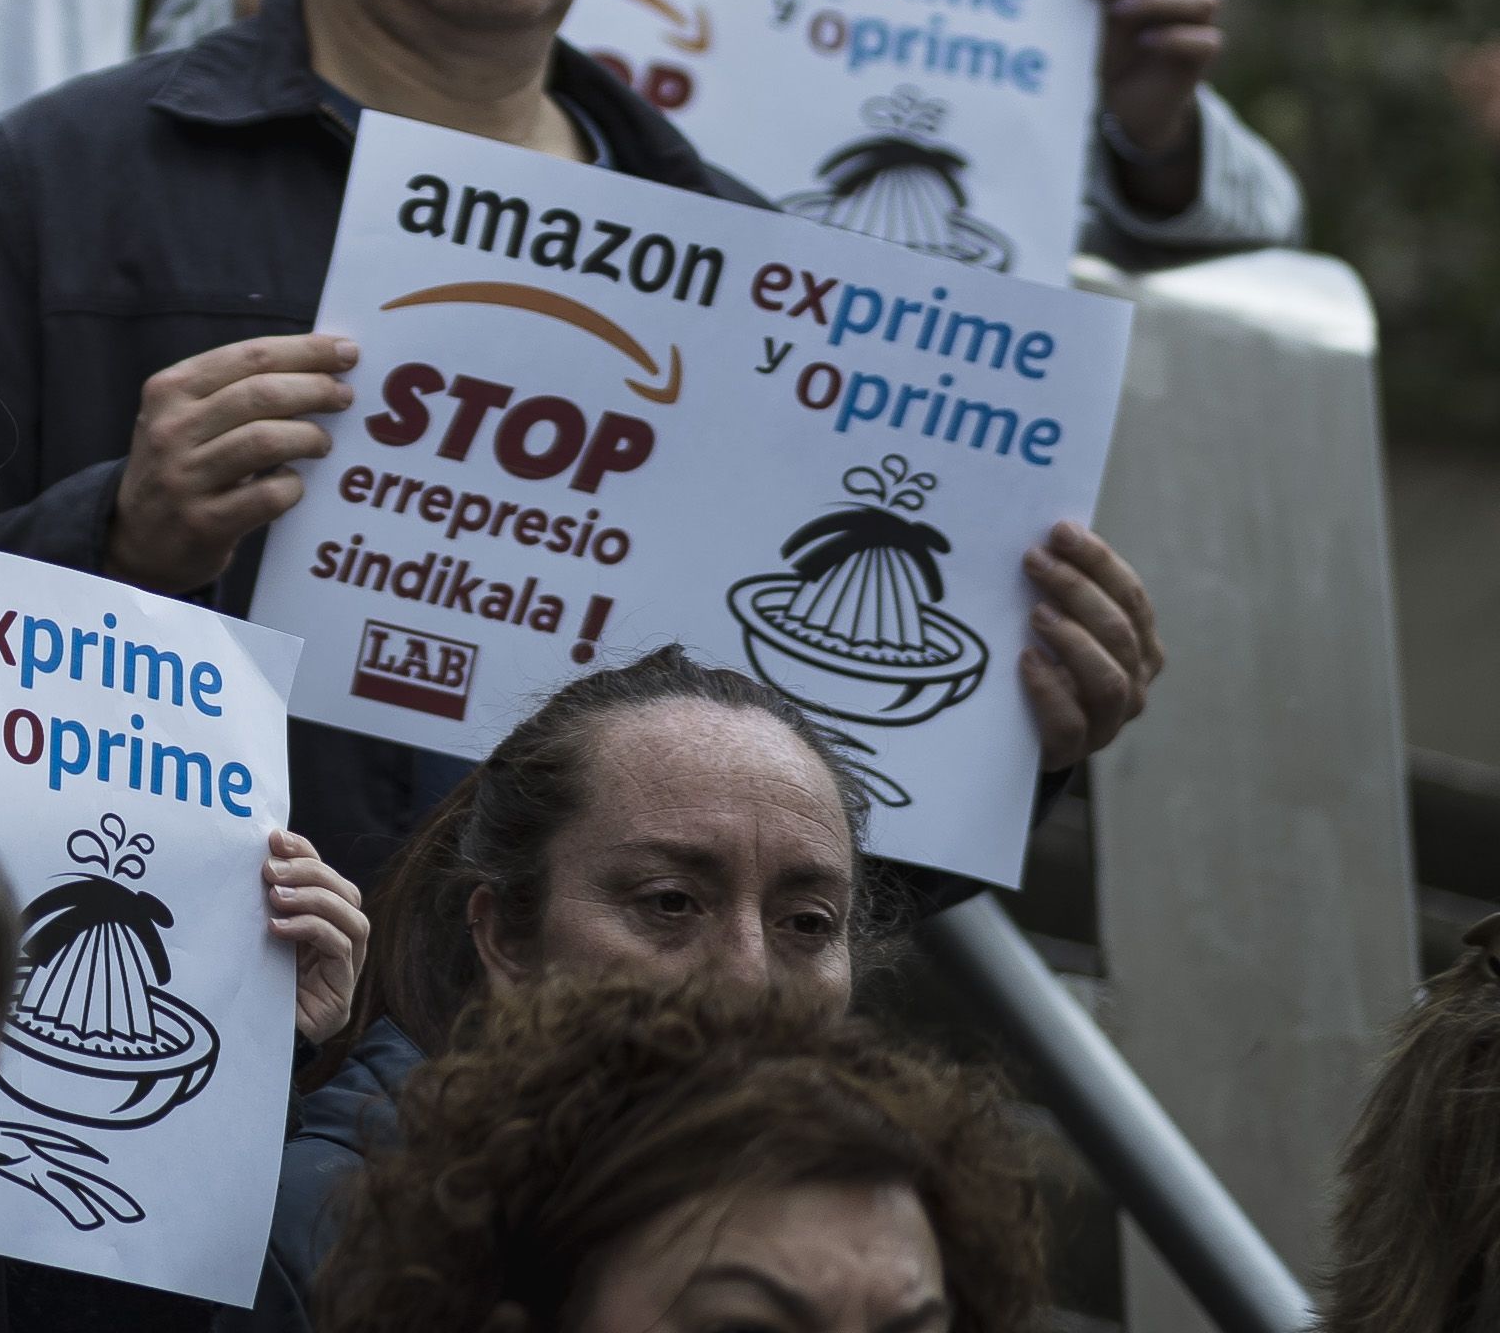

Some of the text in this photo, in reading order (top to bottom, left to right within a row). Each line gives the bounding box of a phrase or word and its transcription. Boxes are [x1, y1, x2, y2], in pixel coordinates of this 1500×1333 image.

[806, 6, 1049, 93] oprime
[399, 174, 1053, 378] amazon exprime
[365, 363, 655, 494] STOP
[756, 337, 1060, 465] y oprime
[340, 466, 630, 565] errepresio
[363, 629, 474, 693] LAB
[3, 689, 256, 821] oprime
